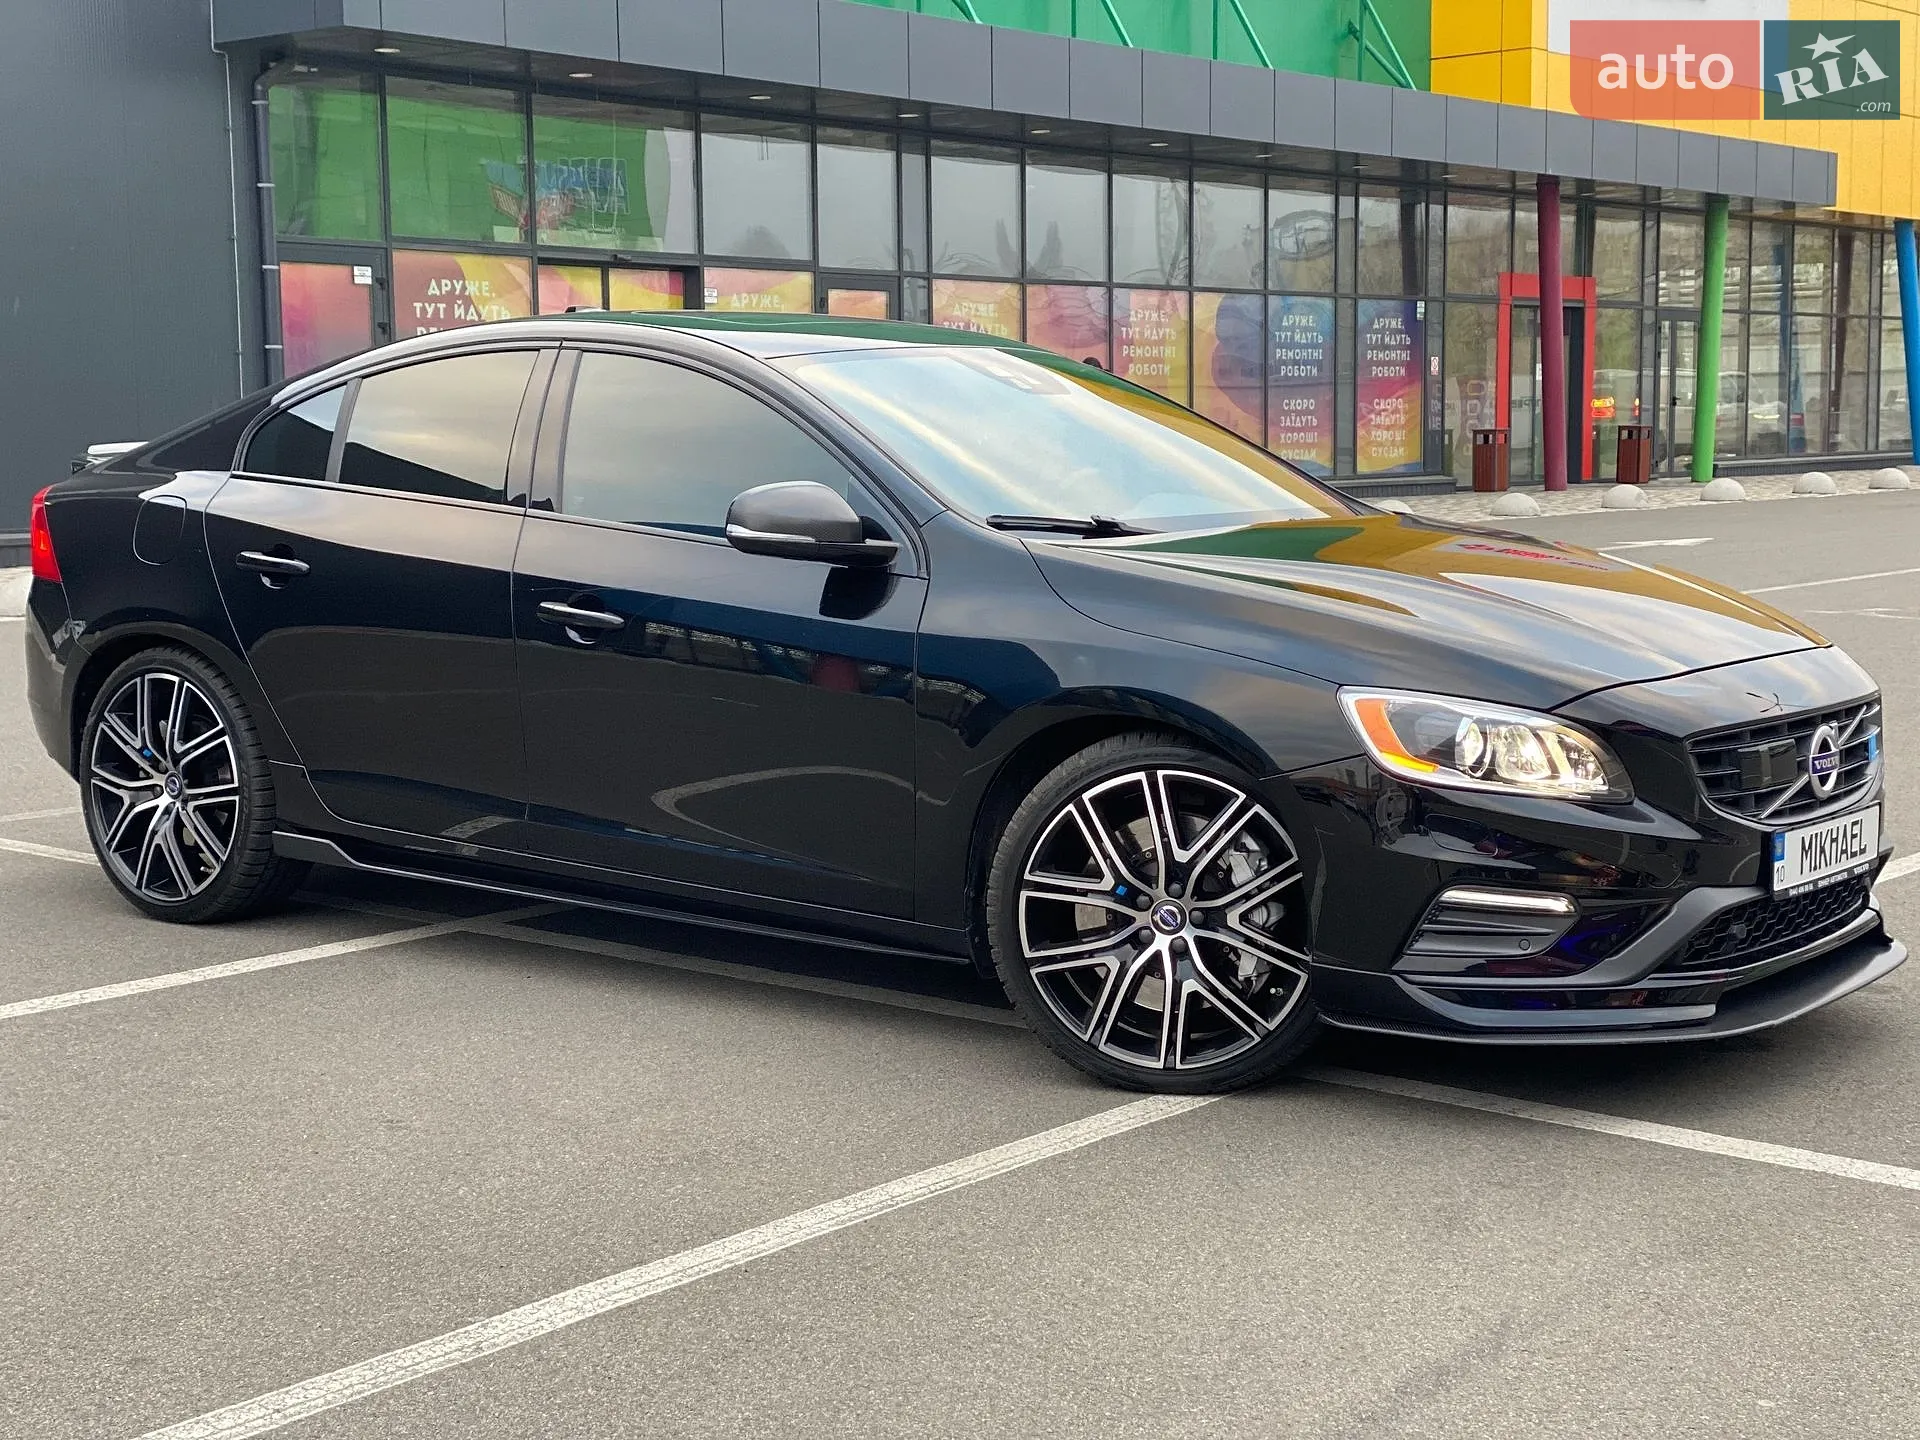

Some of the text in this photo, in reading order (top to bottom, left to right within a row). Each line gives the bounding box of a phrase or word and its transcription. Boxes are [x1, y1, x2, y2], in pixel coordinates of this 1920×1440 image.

[731, 292, 785, 310] ДРУЖЕ,
[413, 300, 512, 321] ТУТ ЙДУТЬ
[1129, 308, 1169, 322] ДРУЖЕ,
[1282, 314, 1316, 328] ДРУЖЕ,
[1372, 317, 1405, 329] ДРУЖЕ,
[1121, 324, 1177, 340] ТУТ ЙДУТЬ
[1275, 328, 1324, 344] ТУТ ЙДУТЬ
[1366, 331, 1411, 345] ТУТ ЙДУТЬ
[1122, 345, 1177, 358] РЕМОНТНІ
[1275, 348, 1323, 360] РЕМОНТНІ
[1366, 350, 1411, 361] РЕМОНТНІ
[1128, 363, 1170, 376] РОБОТИ
[1280, 365, 1318, 377] РОБОТИ
[1371, 366, 1406, 377] РОБОТИ
[1283, 399, 1316, 410] СКОРО
[1373, 398, 1404, 409] СКОРО
[1279, 412, 1318, 427] ЗАЇДУТЬ
[1279, 431, 1318, 443] ХОРОШІ
[1370, 430, 1406, 441] ХОРОШІ
[1280, 447, 1317, 460] СУСІДИ
[1800, 818, 1867, 876] MIKHAEL
[1775, 865, 1785, 885] 10
